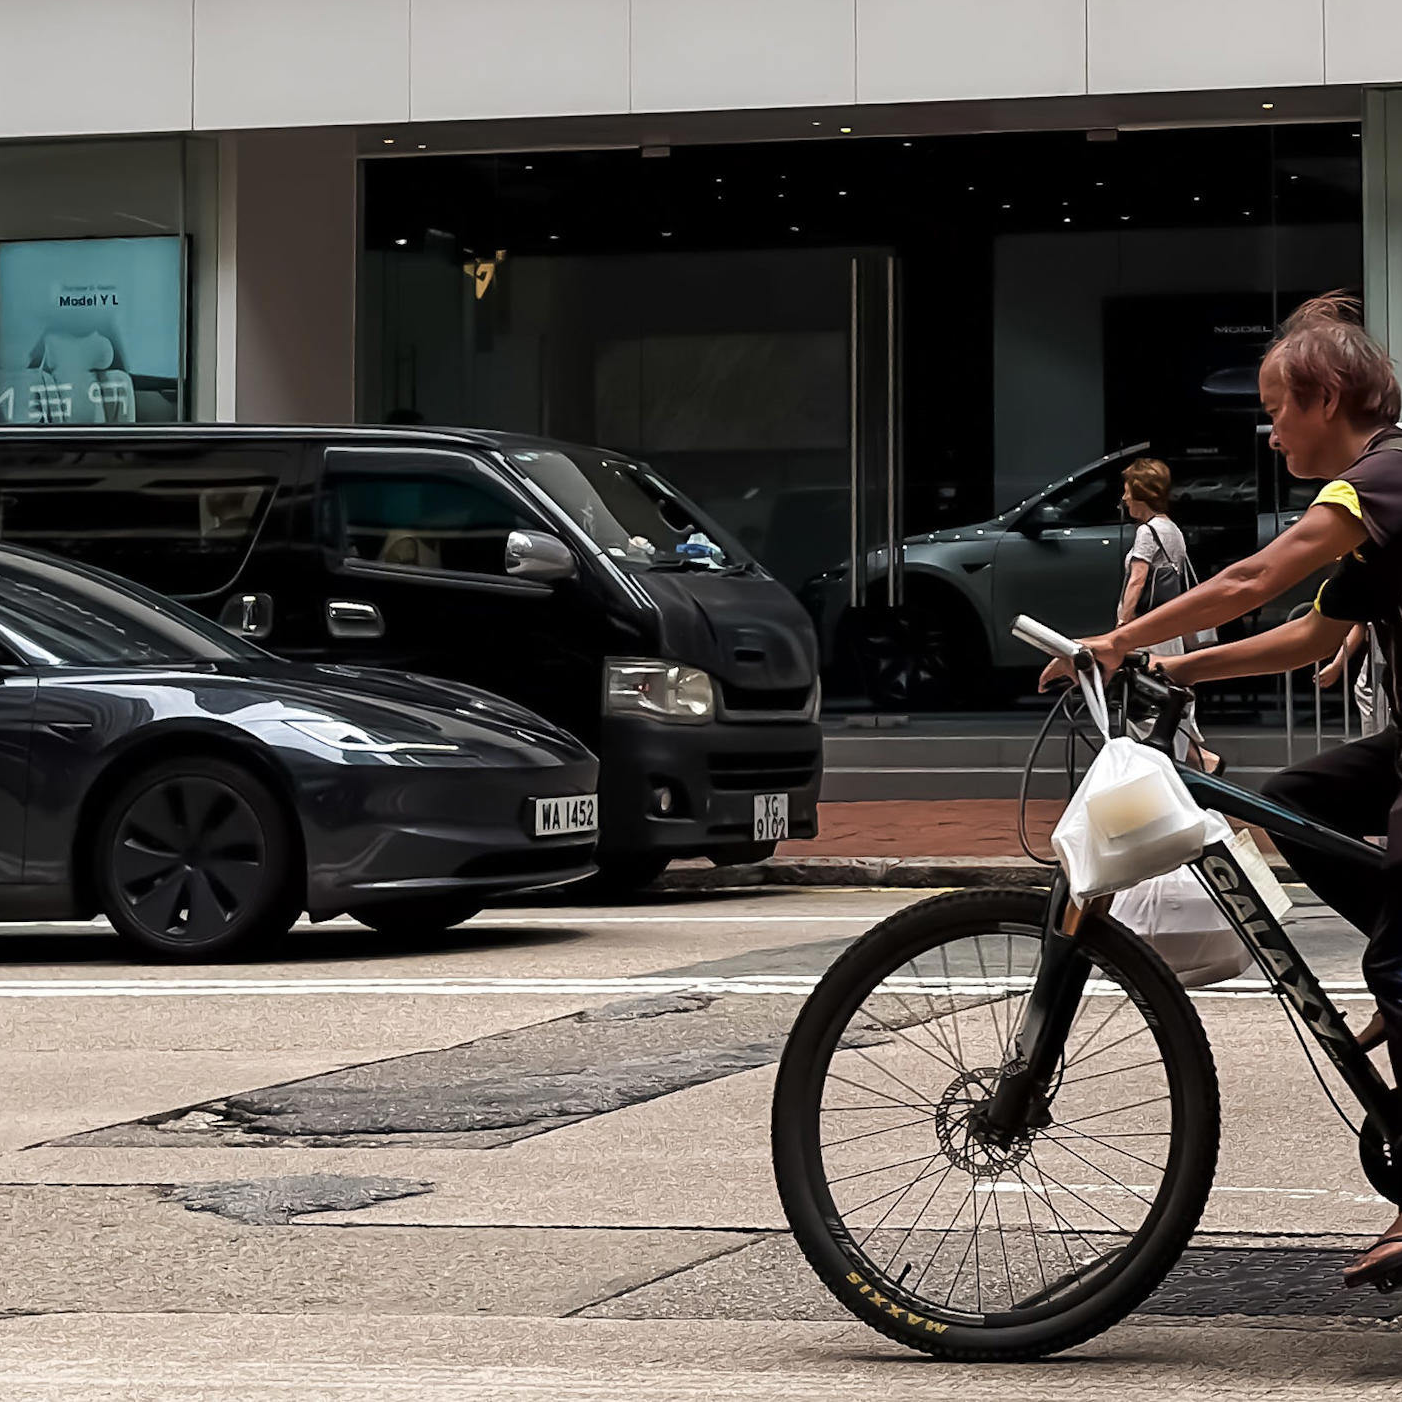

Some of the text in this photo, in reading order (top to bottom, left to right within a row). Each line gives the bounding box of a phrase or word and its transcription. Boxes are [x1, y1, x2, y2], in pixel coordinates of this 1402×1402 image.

[59, 295, 119, 307] Model Y L
[542, 799, 594, 831] WA 1452
[845, 1271, 949, 1335] MAXXIS
